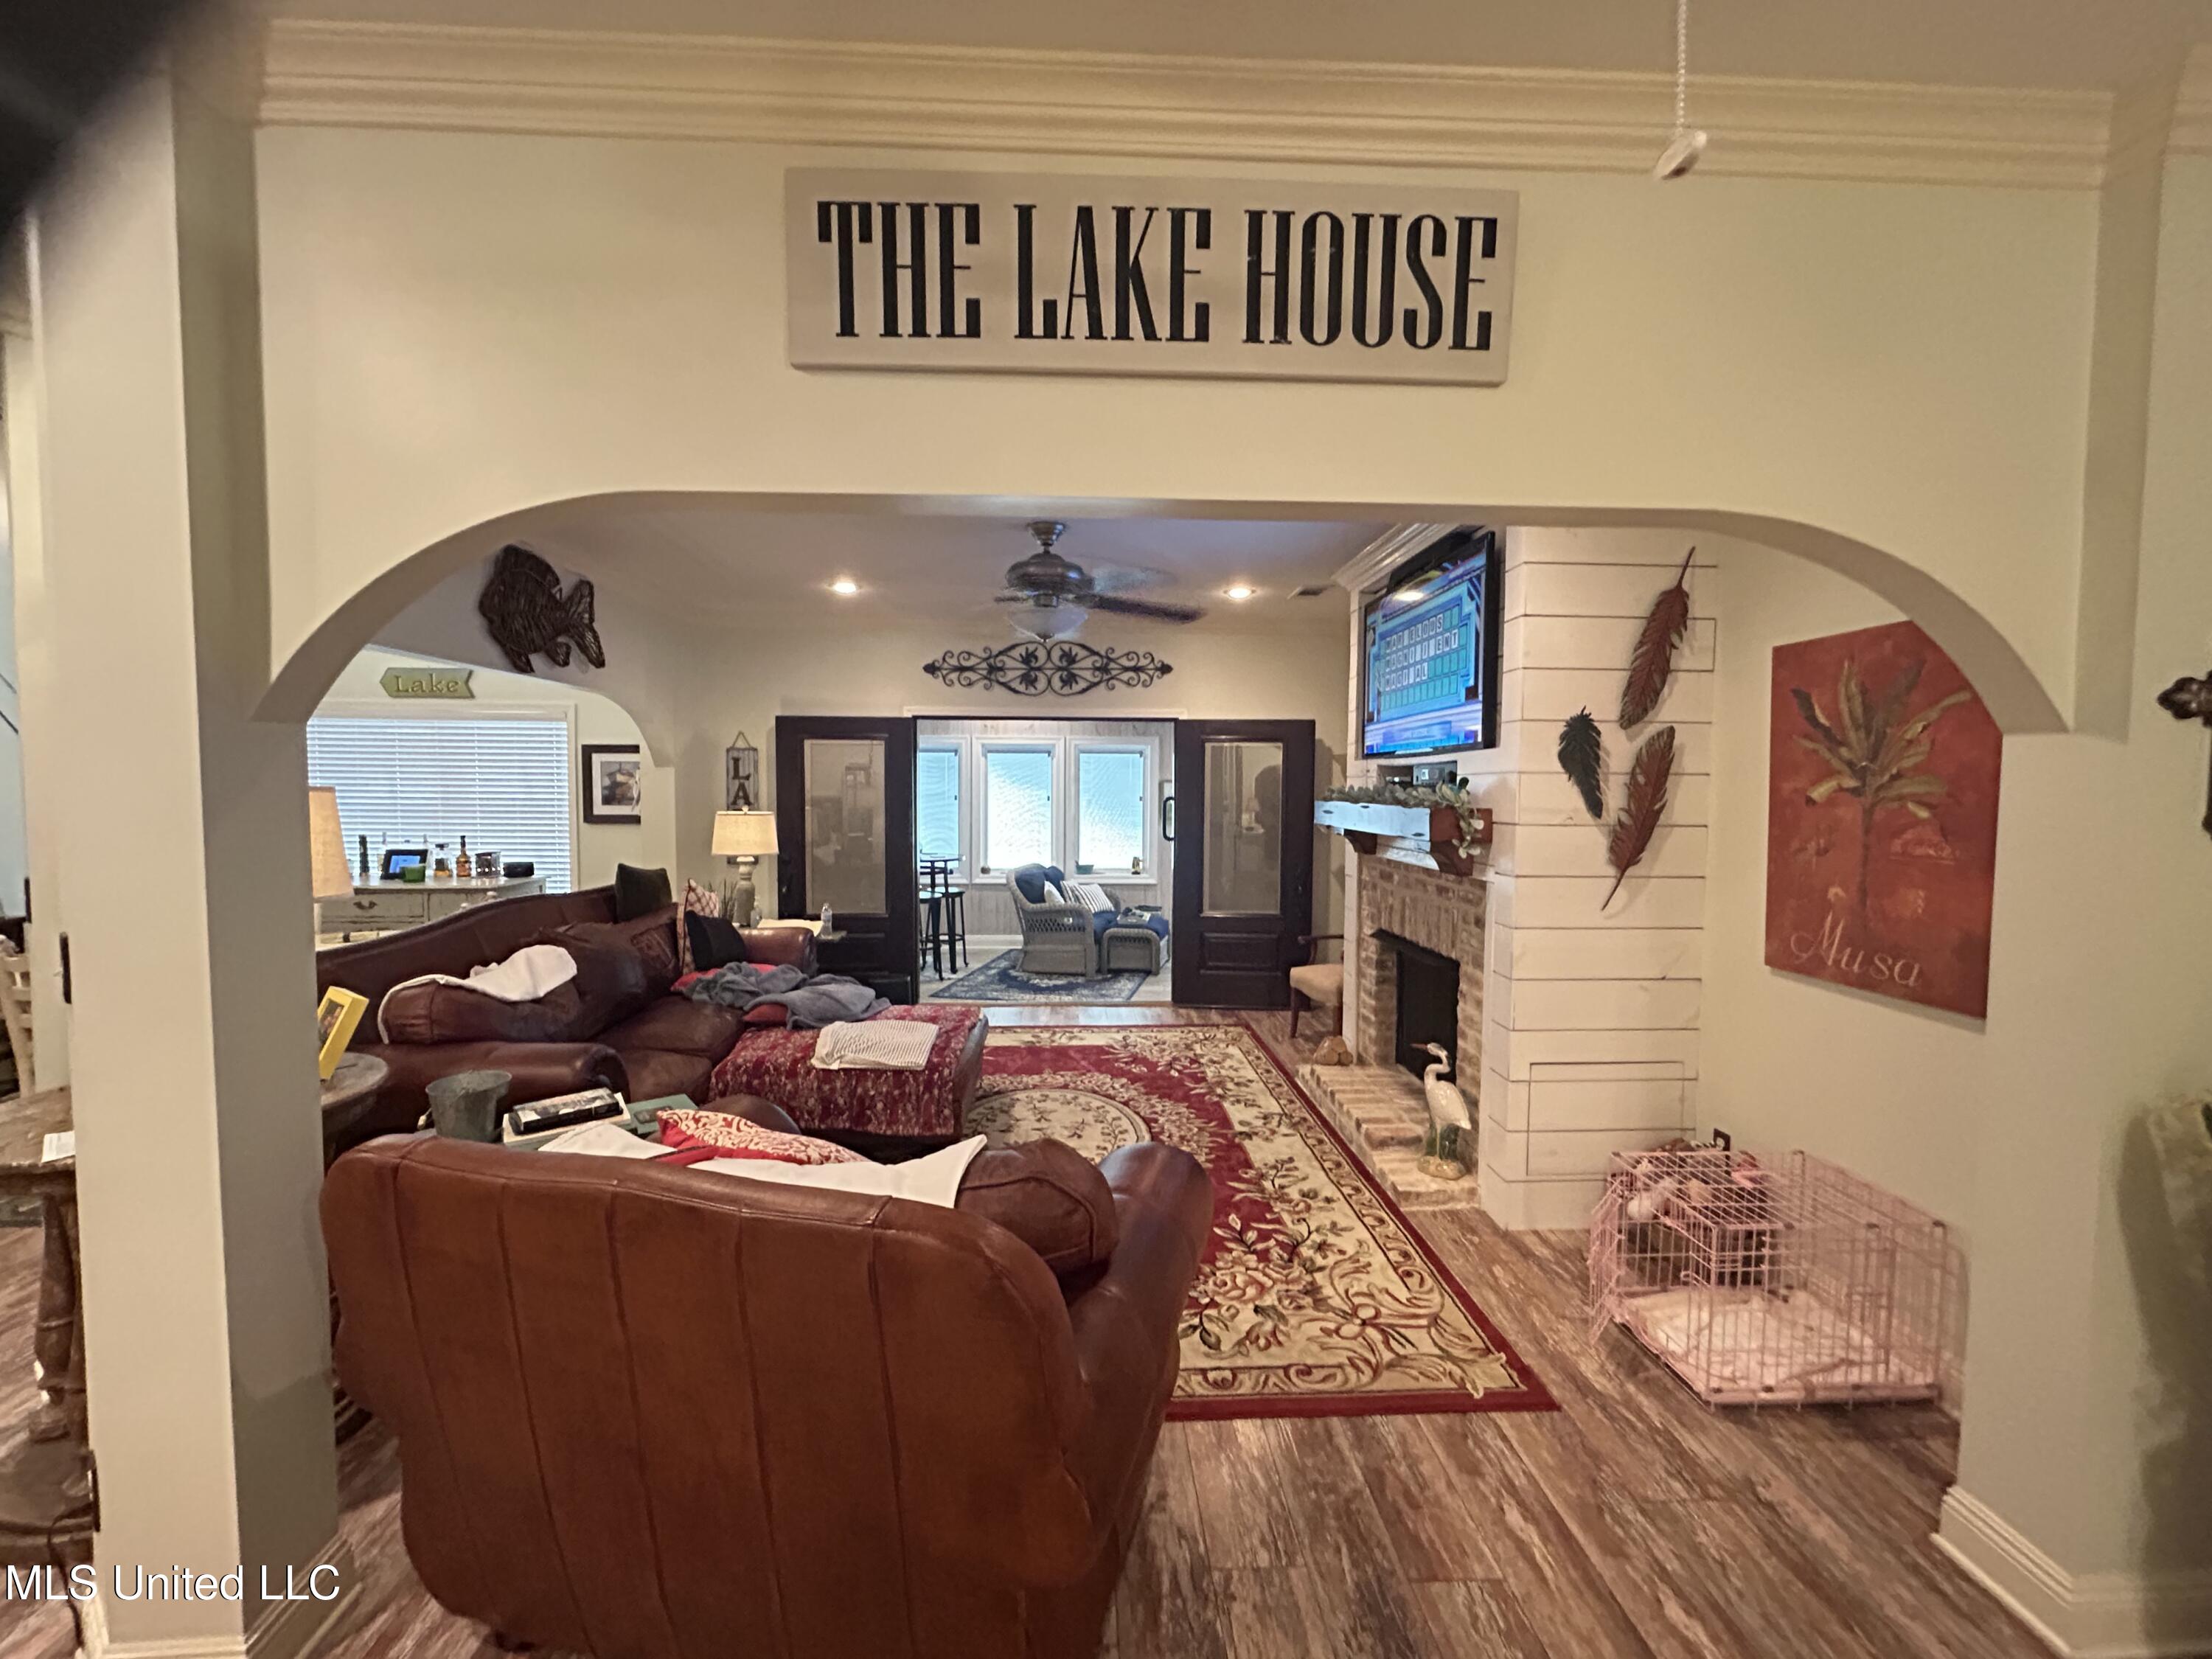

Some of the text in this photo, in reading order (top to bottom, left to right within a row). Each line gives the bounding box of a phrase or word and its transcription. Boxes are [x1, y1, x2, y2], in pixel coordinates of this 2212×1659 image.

[817, 201, 1498, 352] THE LAKE HOUSE
[394, 672, 459, 693] Lake
[731, 757, 753, 811] LA
[1790, 909, 1921, 987] Musa
